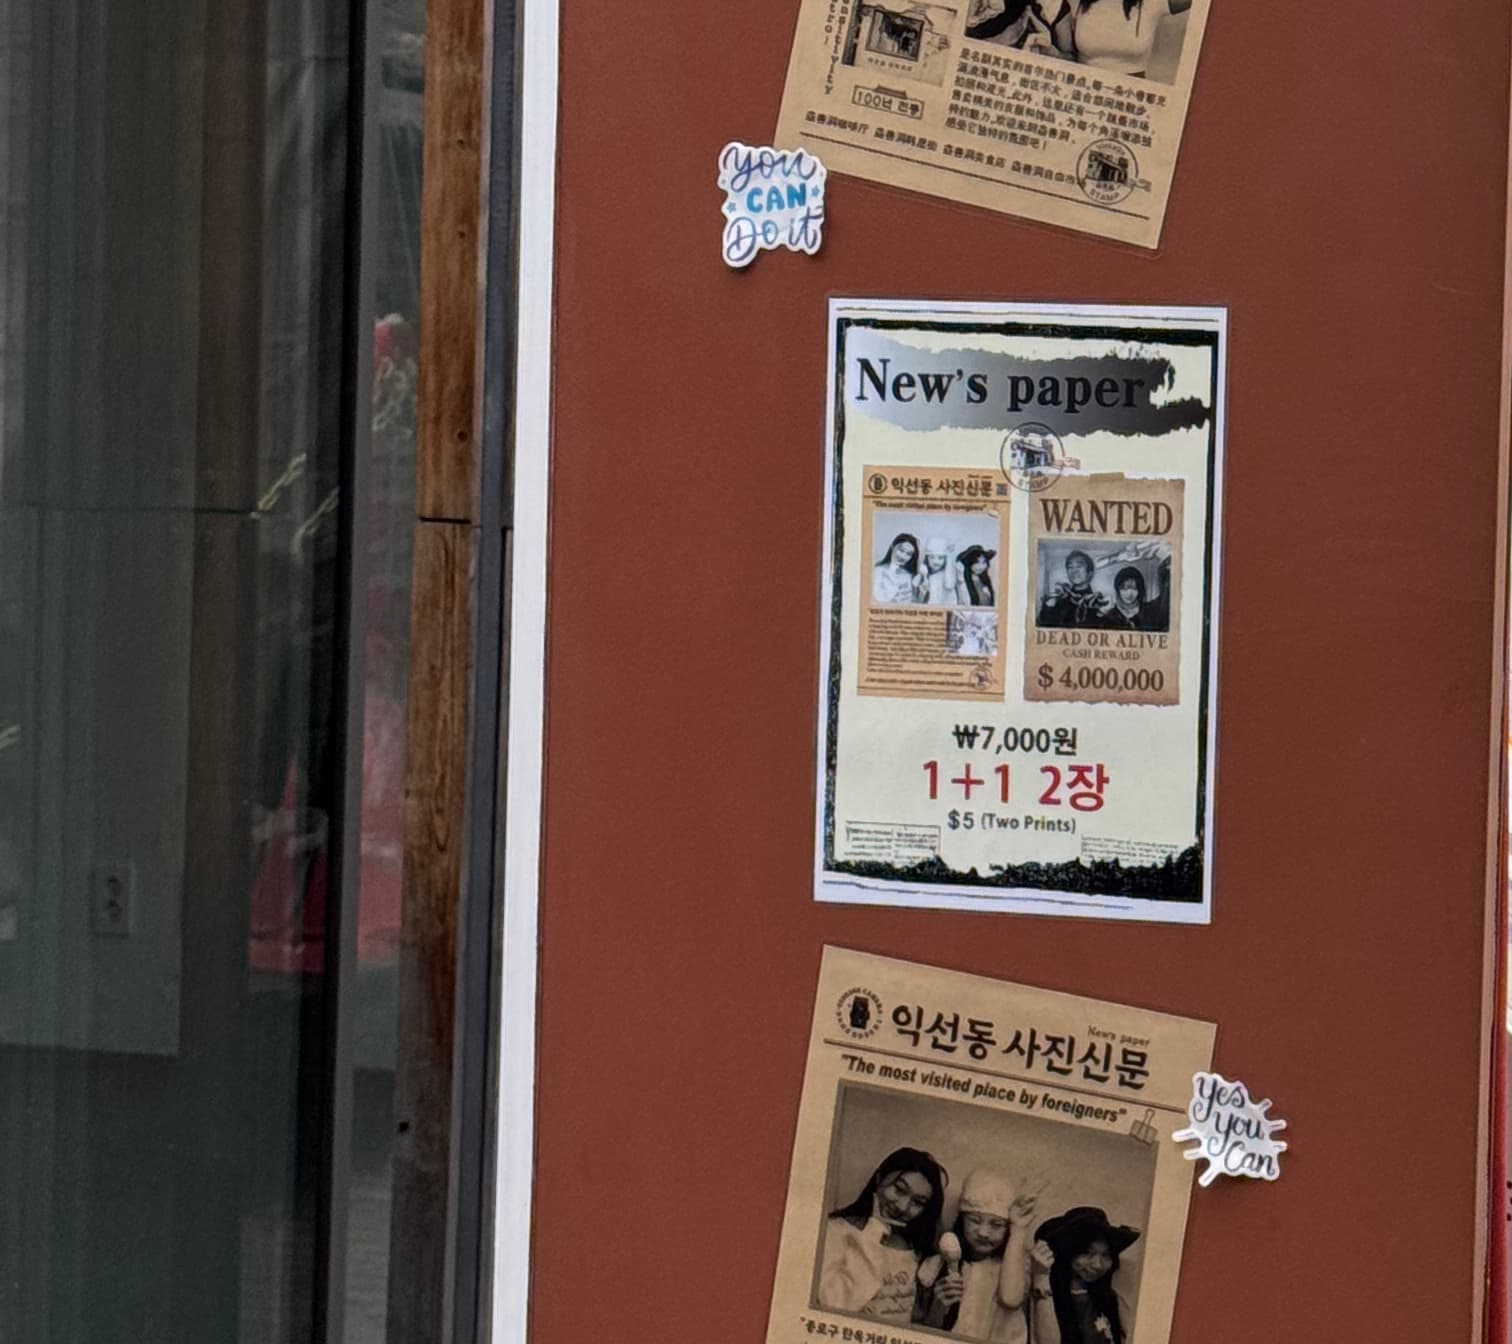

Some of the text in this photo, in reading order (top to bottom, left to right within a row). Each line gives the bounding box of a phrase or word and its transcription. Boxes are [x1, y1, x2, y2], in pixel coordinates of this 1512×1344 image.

[723, 146, 817, 195] you
[745, 183, 807, 212] CAN
[726, 204, 824, 262] Do it
[855, 357, 1146, 413] New's paper
[891, 476, 993, 499] 익선동 사진신문
[1040, 498, 1173, 536] WANTED
[1035, 629, 1168, 651] DEAD OR ALIVE
[1061, 647, 1140, 661] CASH REWARD
[1037, 662, 1165, 692] $ 4,000,000
[952, 724, 1078, 756] ₩7,000원
[922, 759, 1110, 812] 1+1 2장
[947, 808, 1077, 835] $5 (Two Prints)
[891, 1003, 1151, 1091] 익선동 사진신문
[843, 1053, 1127, 1122] "The most visited place by foreigners"
[1206, 1113, 1265, 1156] you
[1223, 1150, 1276, 1177] Can
